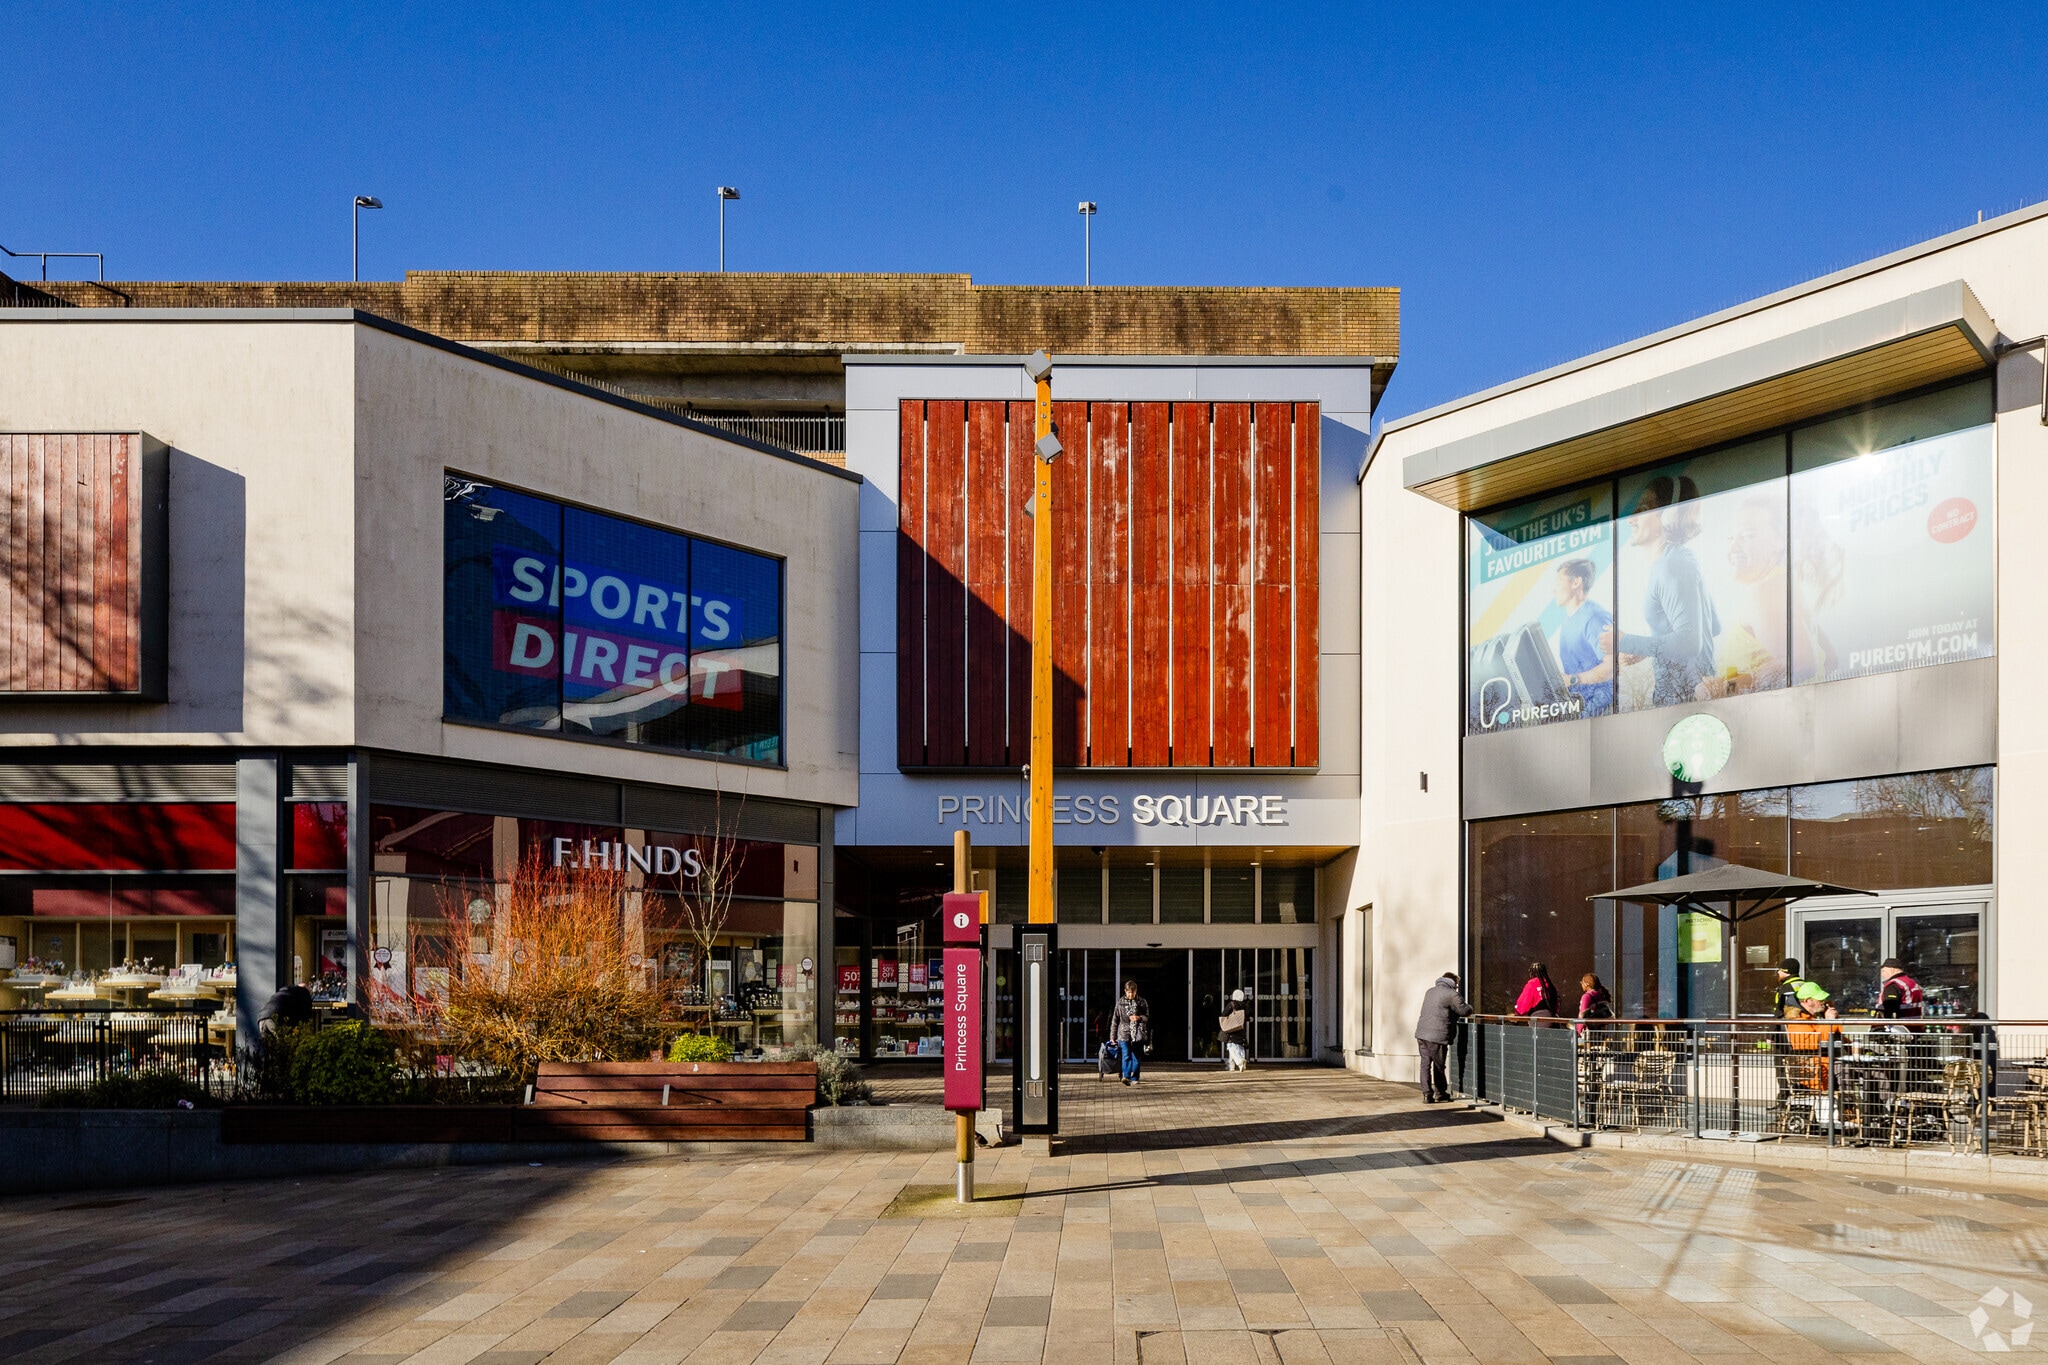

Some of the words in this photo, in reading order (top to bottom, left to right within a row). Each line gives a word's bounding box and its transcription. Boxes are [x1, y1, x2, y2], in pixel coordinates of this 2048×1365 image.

[1520, 518, 1548, 542] THE
[1551, 504, 1585, 530] UK'S
[1851, 483, 1929, 532] PRICES
[1931, 511, 1975, 534] CONTRACT
[1946, 508, 1959, 519] NO
[1487, 536, 1566, 578] FAVOURITE
[1569, 522, 1602, 548] GYM
[509, 556, 731, 641] SPORTS
[1907, 626, 1929, 640] JOIN
[1932, 620, 1964, 635] TODAY
[1965, 618, 1978, 630] AT
[510, 622, 730, 700] DIRECT
[1849, 632, 1978, 669] PUREGYM.COM
[1512, 699, 1580, 723] PUREGYM
[938, 795, 1120, 825] PRINESS
[1132, 795, 1285, 827] SQUARE
[955, 963, 968, 1012] Square
[955, 1015, 967, 1071] Princess
